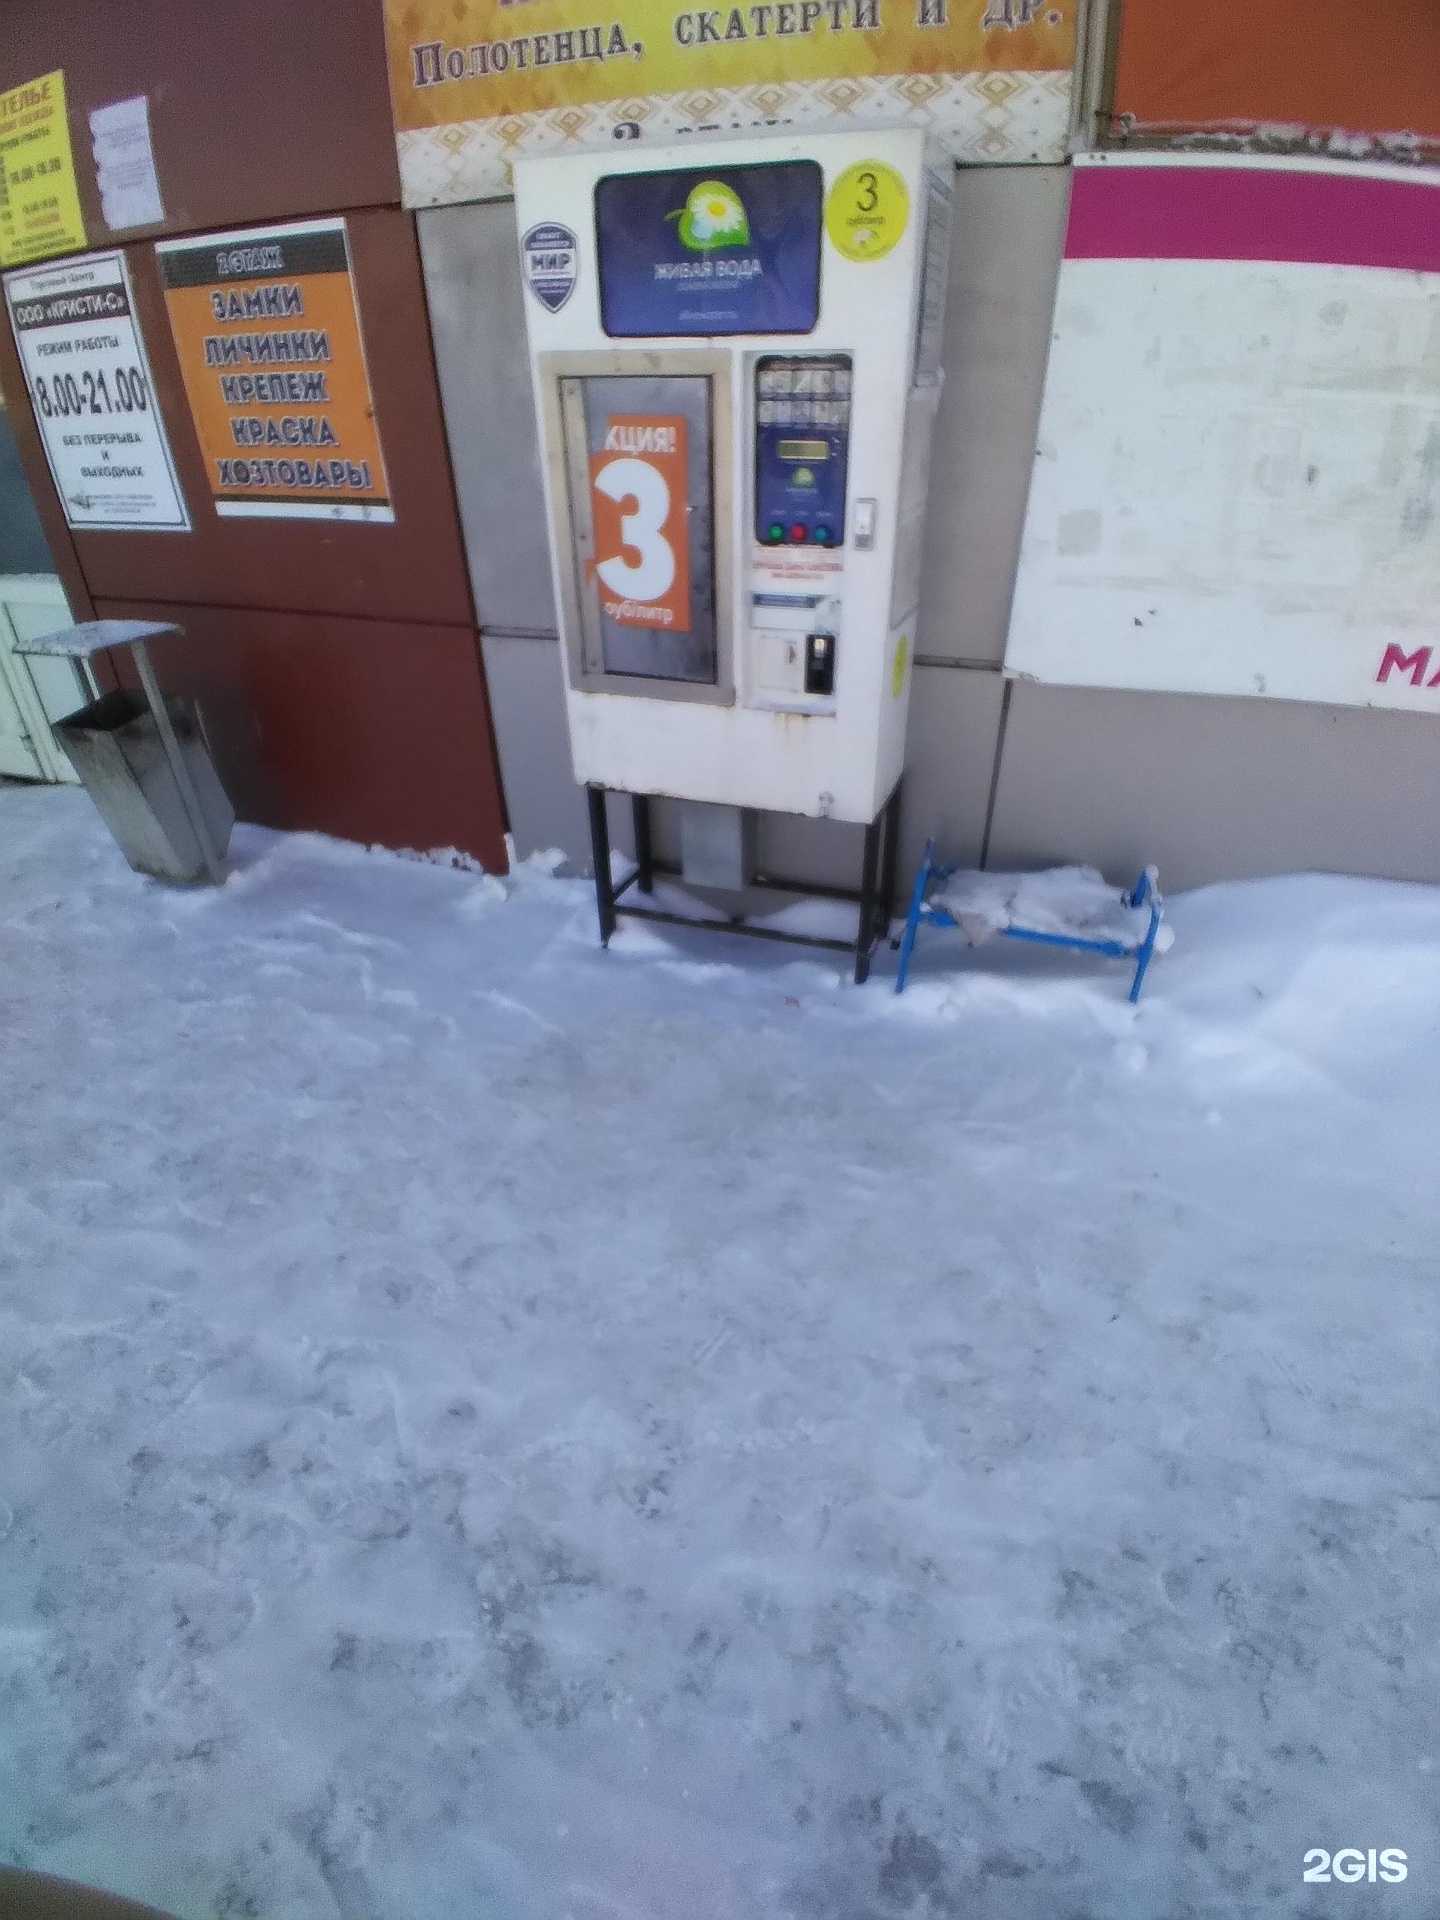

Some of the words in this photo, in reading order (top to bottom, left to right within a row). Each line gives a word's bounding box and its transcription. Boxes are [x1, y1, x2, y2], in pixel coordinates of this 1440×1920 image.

[856, 172, 879, 212] 3
[210, 283, 304, 322] ЗАМКИ
[74, 334, 120, 353] РАБОТЫ
[36, 366, 147, 418] 8.00-21.00
[219, 371, 331, 405] КРЕПЕЖ
[84, 431, 143, 446] ПЕРЕРЫВА
[229, 415, 341, 447] КРАСКА
[80, 465, 144, 479] ВЫХОДНЫХ
[216, 457, 374, 490] ХОЗТОВАРЫ
[594, 458, 677, 601] 3
